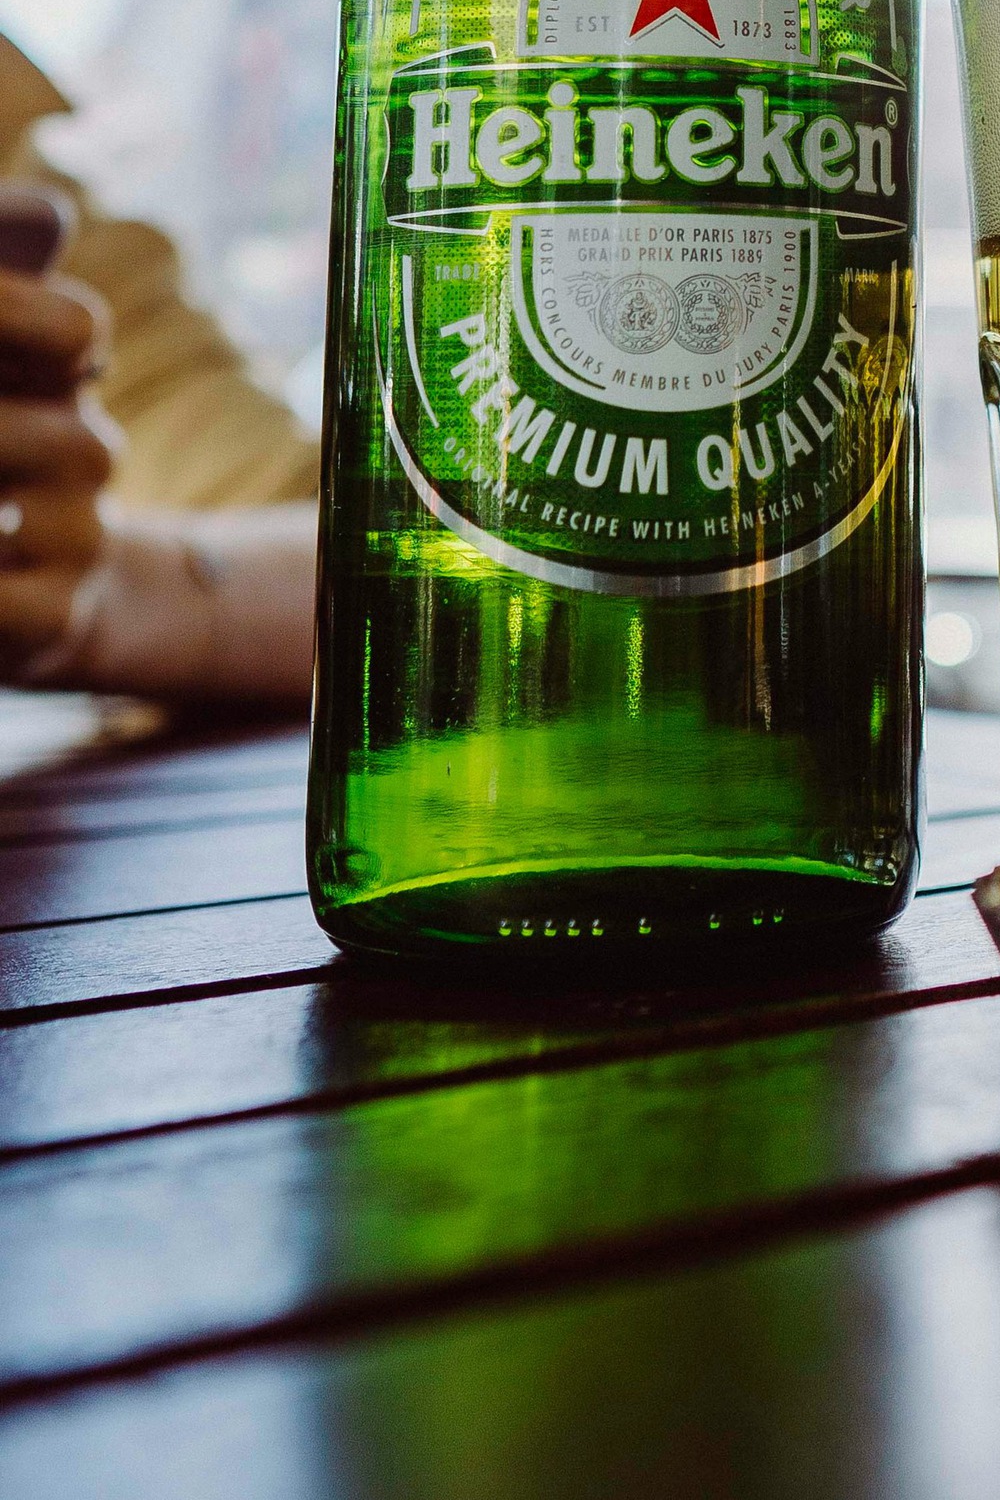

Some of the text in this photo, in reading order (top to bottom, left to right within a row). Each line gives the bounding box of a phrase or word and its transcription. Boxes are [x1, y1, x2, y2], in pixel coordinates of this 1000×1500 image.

[575, 15, 611, 32] EST
[733, 19, 772, 39] 1873
[783, 9, 797, 51] 1883
[568, 227, 773, 245] MEDALLE D'OR PARIS 1875
[639, 247, 674, 262] PRIX
[681, 248, 723, 263] PARIS
[732, 248, 764, 264] 1889
[540, 228, 797, 390] HORS CONCOURS MEMBRE DU JURY PARIS 1900
[440, 311, 870, 496] PREMIUM QUALITY
[540, 501, 620, 538] RECIPE
[632, 520, 690, 540] WITH
